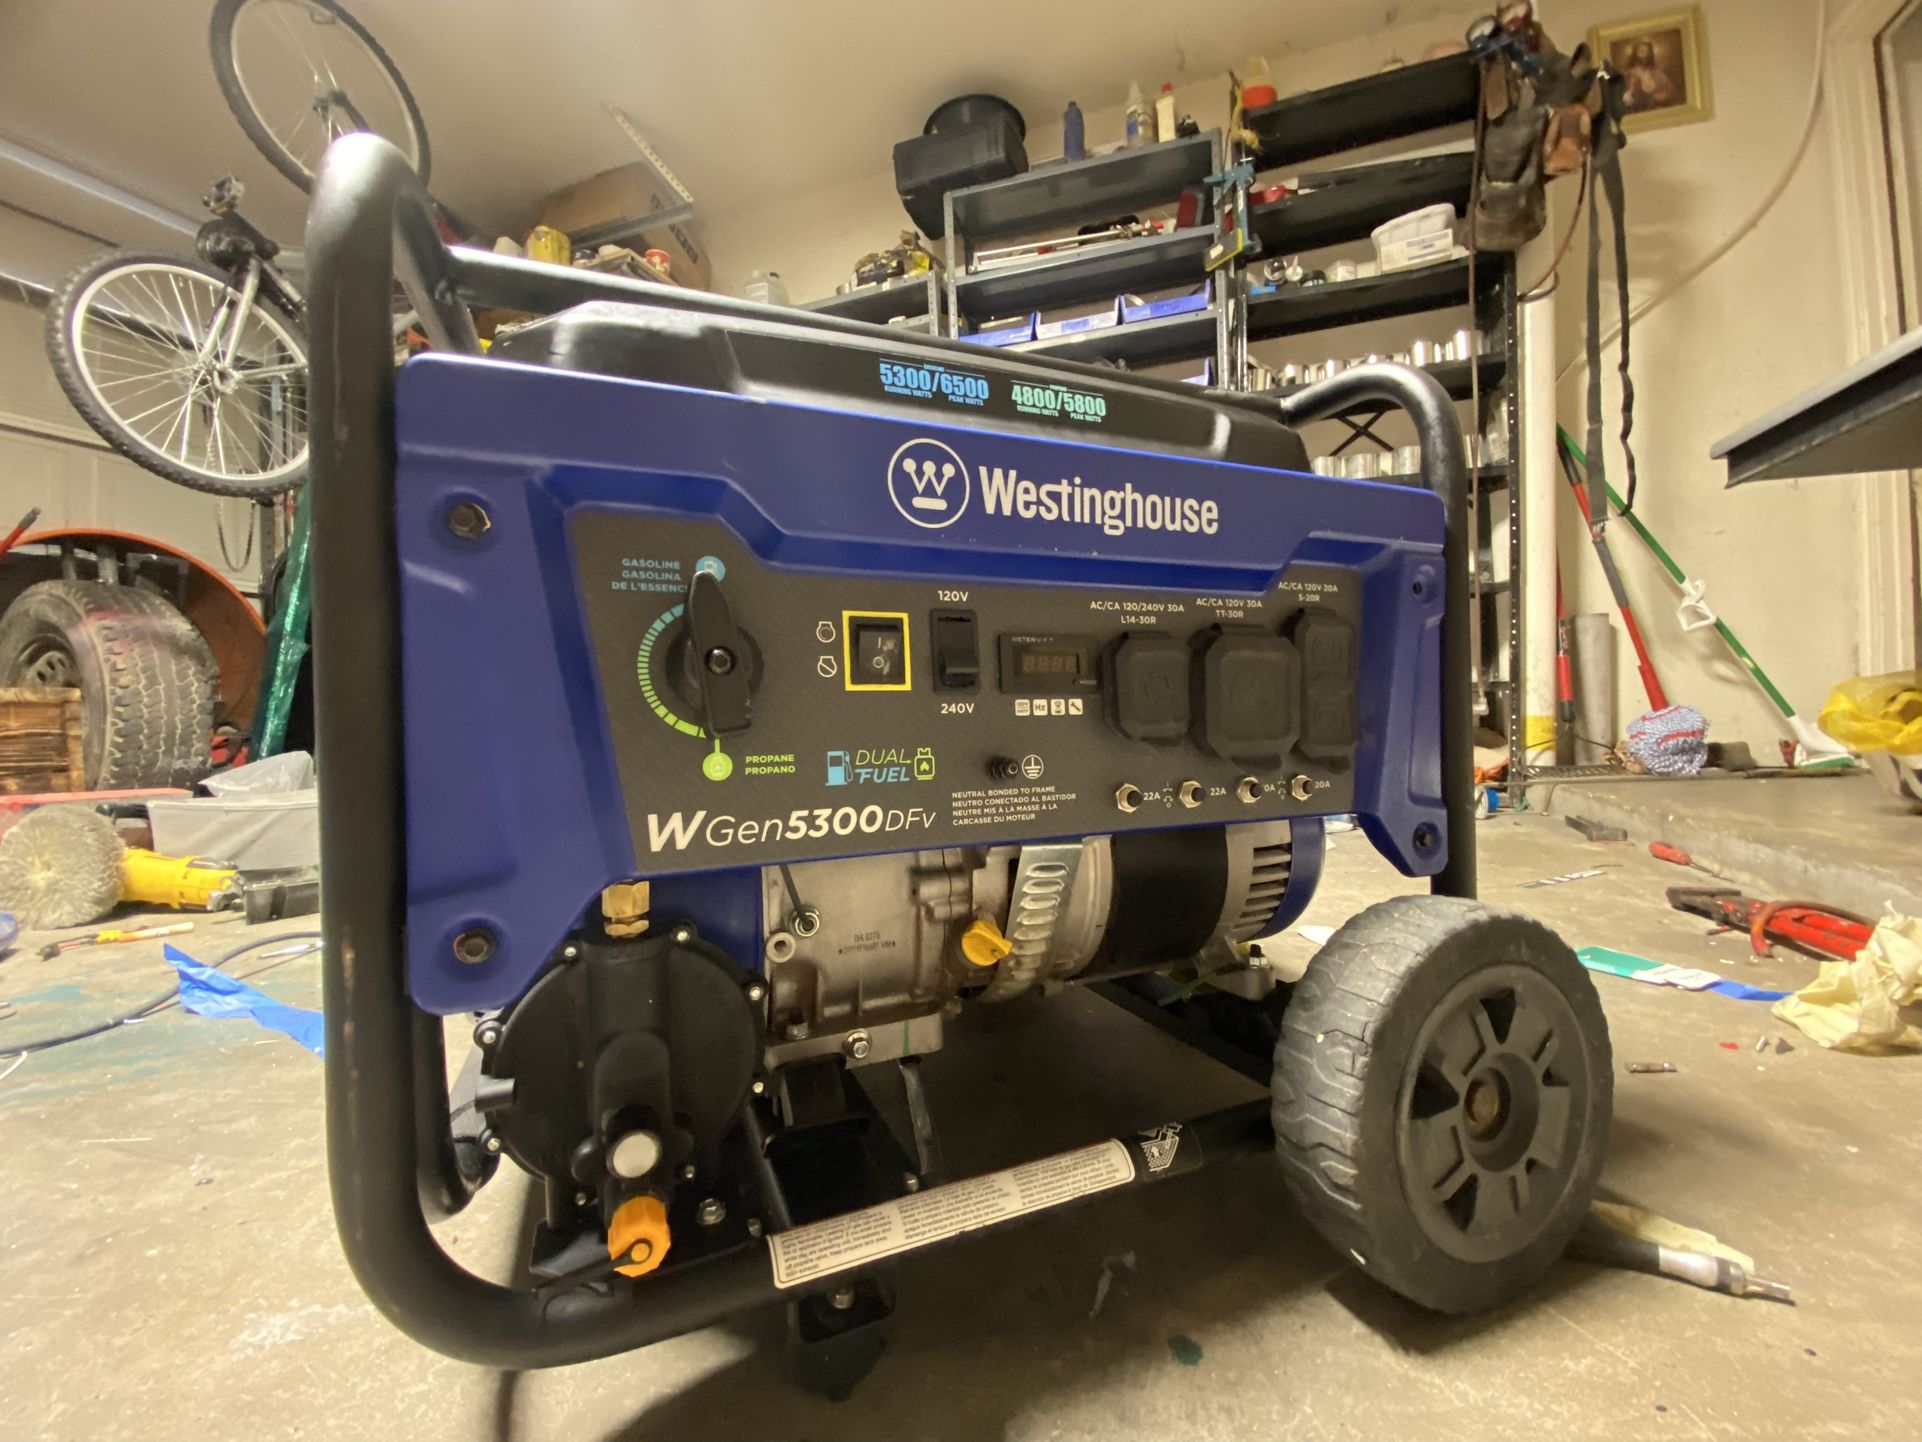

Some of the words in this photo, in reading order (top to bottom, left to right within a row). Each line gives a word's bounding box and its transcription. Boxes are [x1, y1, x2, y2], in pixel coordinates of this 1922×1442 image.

[879, 362, 989, 400] 5300/6500
[1011, 385, 1106, 417] 4800/5800
[1070, 412, 1084, 421] PEAK
[978, 466, 1219, 536] Westinghouse
[622, 558, 681, 570] GASOLINE
[622, 570, 682, 581] GASOLINA
[611, 581, 628, 590] DE
[1278, 581, 1304, 592] AC/CA
[1304, 583, 1323, 592] 120V
[1324, 584, 1339, 593] 20A
[938, 590, 969, 602] 120V
[1090, 600, 1121, 612] AC/CA
[1122, 601, 1165, 613] 120/240V
[1167, 604, 1185, 613] 30A
[1196, 598, 1224, 609] AC/CA
[1225, 600, 1245, 609] 120V
[1246, 601, 1263, 609] 30A
[1121, 614, 1157, 625] L14-30R
[1216, 609, 1244, 619] TT-30R
[940, 703, 975, 715] 240V
[745, 754, 796, 765] PROPANE
[855, 750, 911, 767] DUAL
[745, 765, 797, 776] PROPANO
[856, 768, 911, 784] FUEL
[1314, 779, 1331, 790] 20A
[952, 791, 986, 799] NEUTRAL
[988, 788, 1018, 797] BONDED
[1031, 785, 1056, 794] FRAME
[1143, 791, 1161, 801] 22A
[1210, 786, 1227, 797] 22A
[952, 799, 983, 808] NEUTRO
[984, 796, 1030, 806] CONECTADO
[1041, 793, 1077, 802] BASTIDOR
[952, 808, 982, 817] NEUTRE
[1005, 804, 1016, 813] LA
[1016, 803, 1040, 812] MASSE
[1048, 802, 1058, 810] LA
[952, 817, 992, 826] CARCASSE
[1006, 813, 1036, 822] MOTEUR
